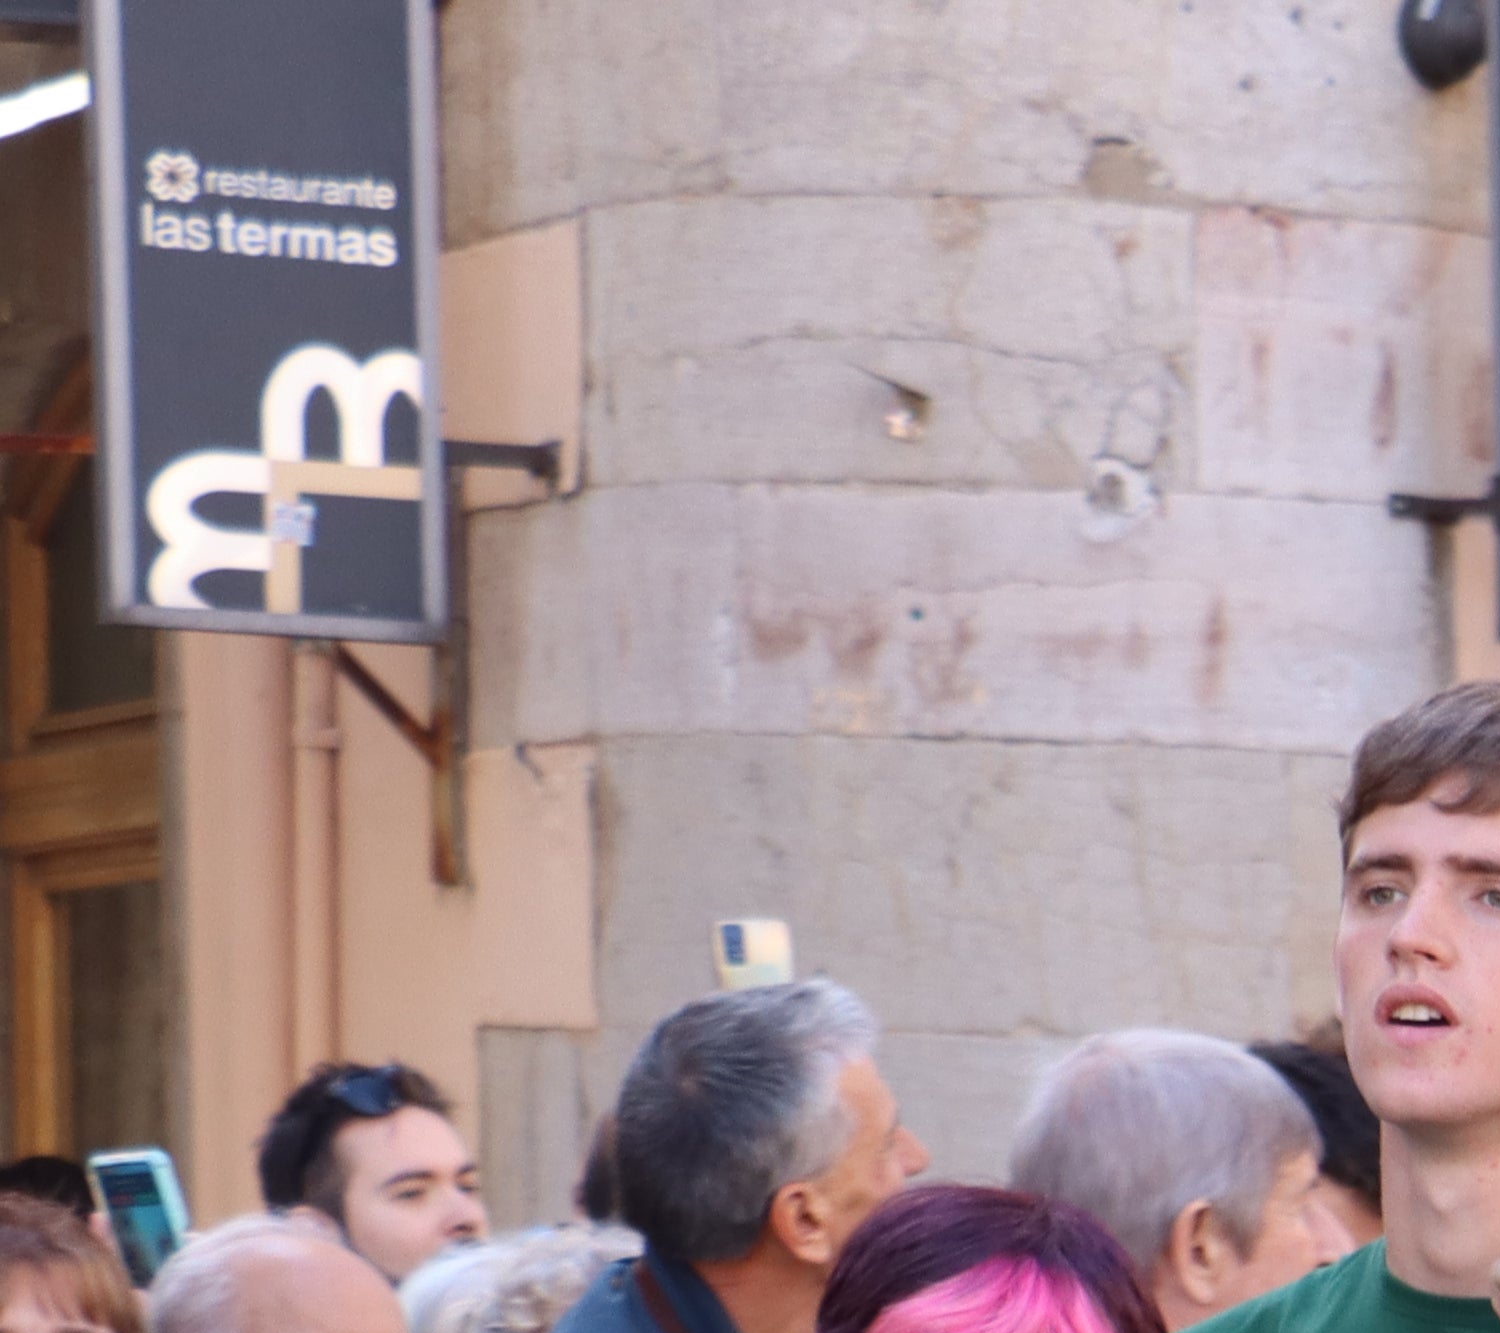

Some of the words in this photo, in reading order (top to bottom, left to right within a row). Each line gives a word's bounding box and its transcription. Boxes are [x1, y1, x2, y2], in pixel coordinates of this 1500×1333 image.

[203, 165, 397, 210] restaurante
[141, 201, 213, 252] las
[216, 208, 398, 268] termas
